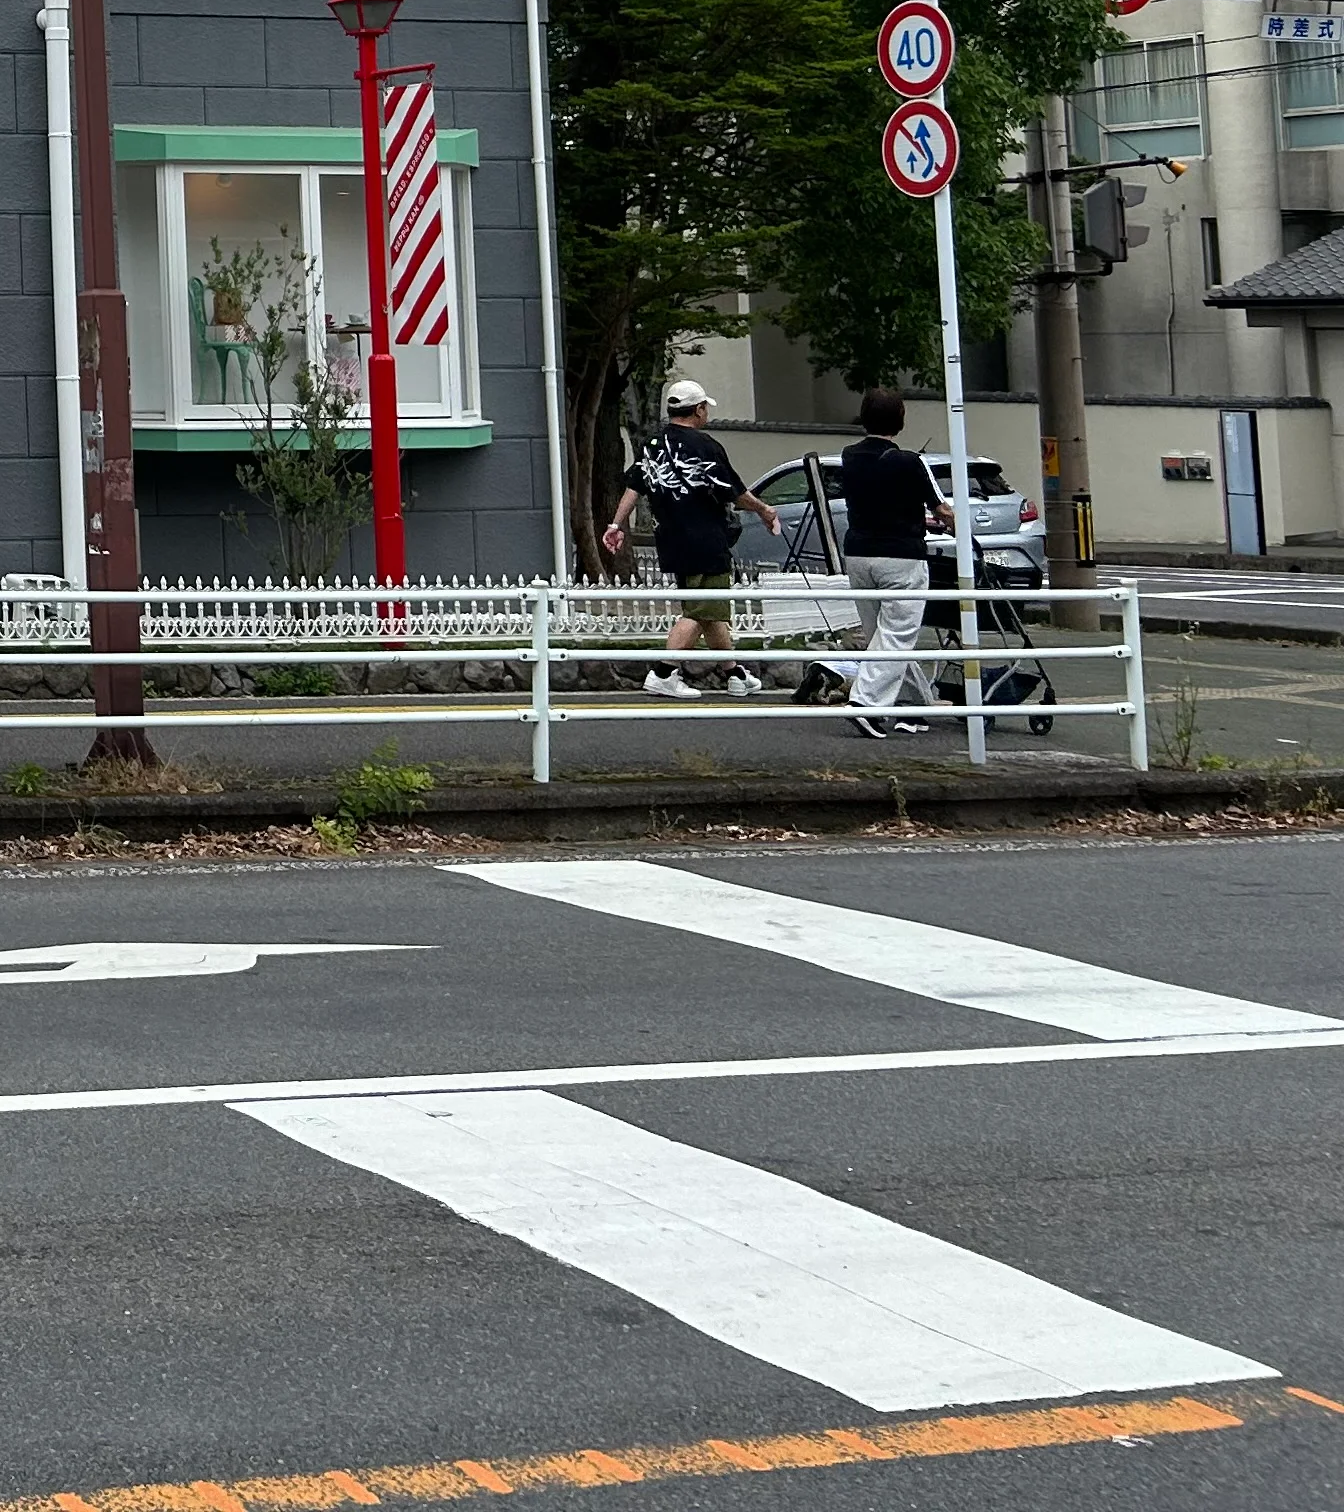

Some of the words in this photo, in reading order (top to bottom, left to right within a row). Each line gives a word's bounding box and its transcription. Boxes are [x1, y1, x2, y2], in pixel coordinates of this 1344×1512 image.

[1267, 17, 1334, 38] 時差式
[896, 27, 936, 71] 40
[408, 204, 420, 224] KAN
